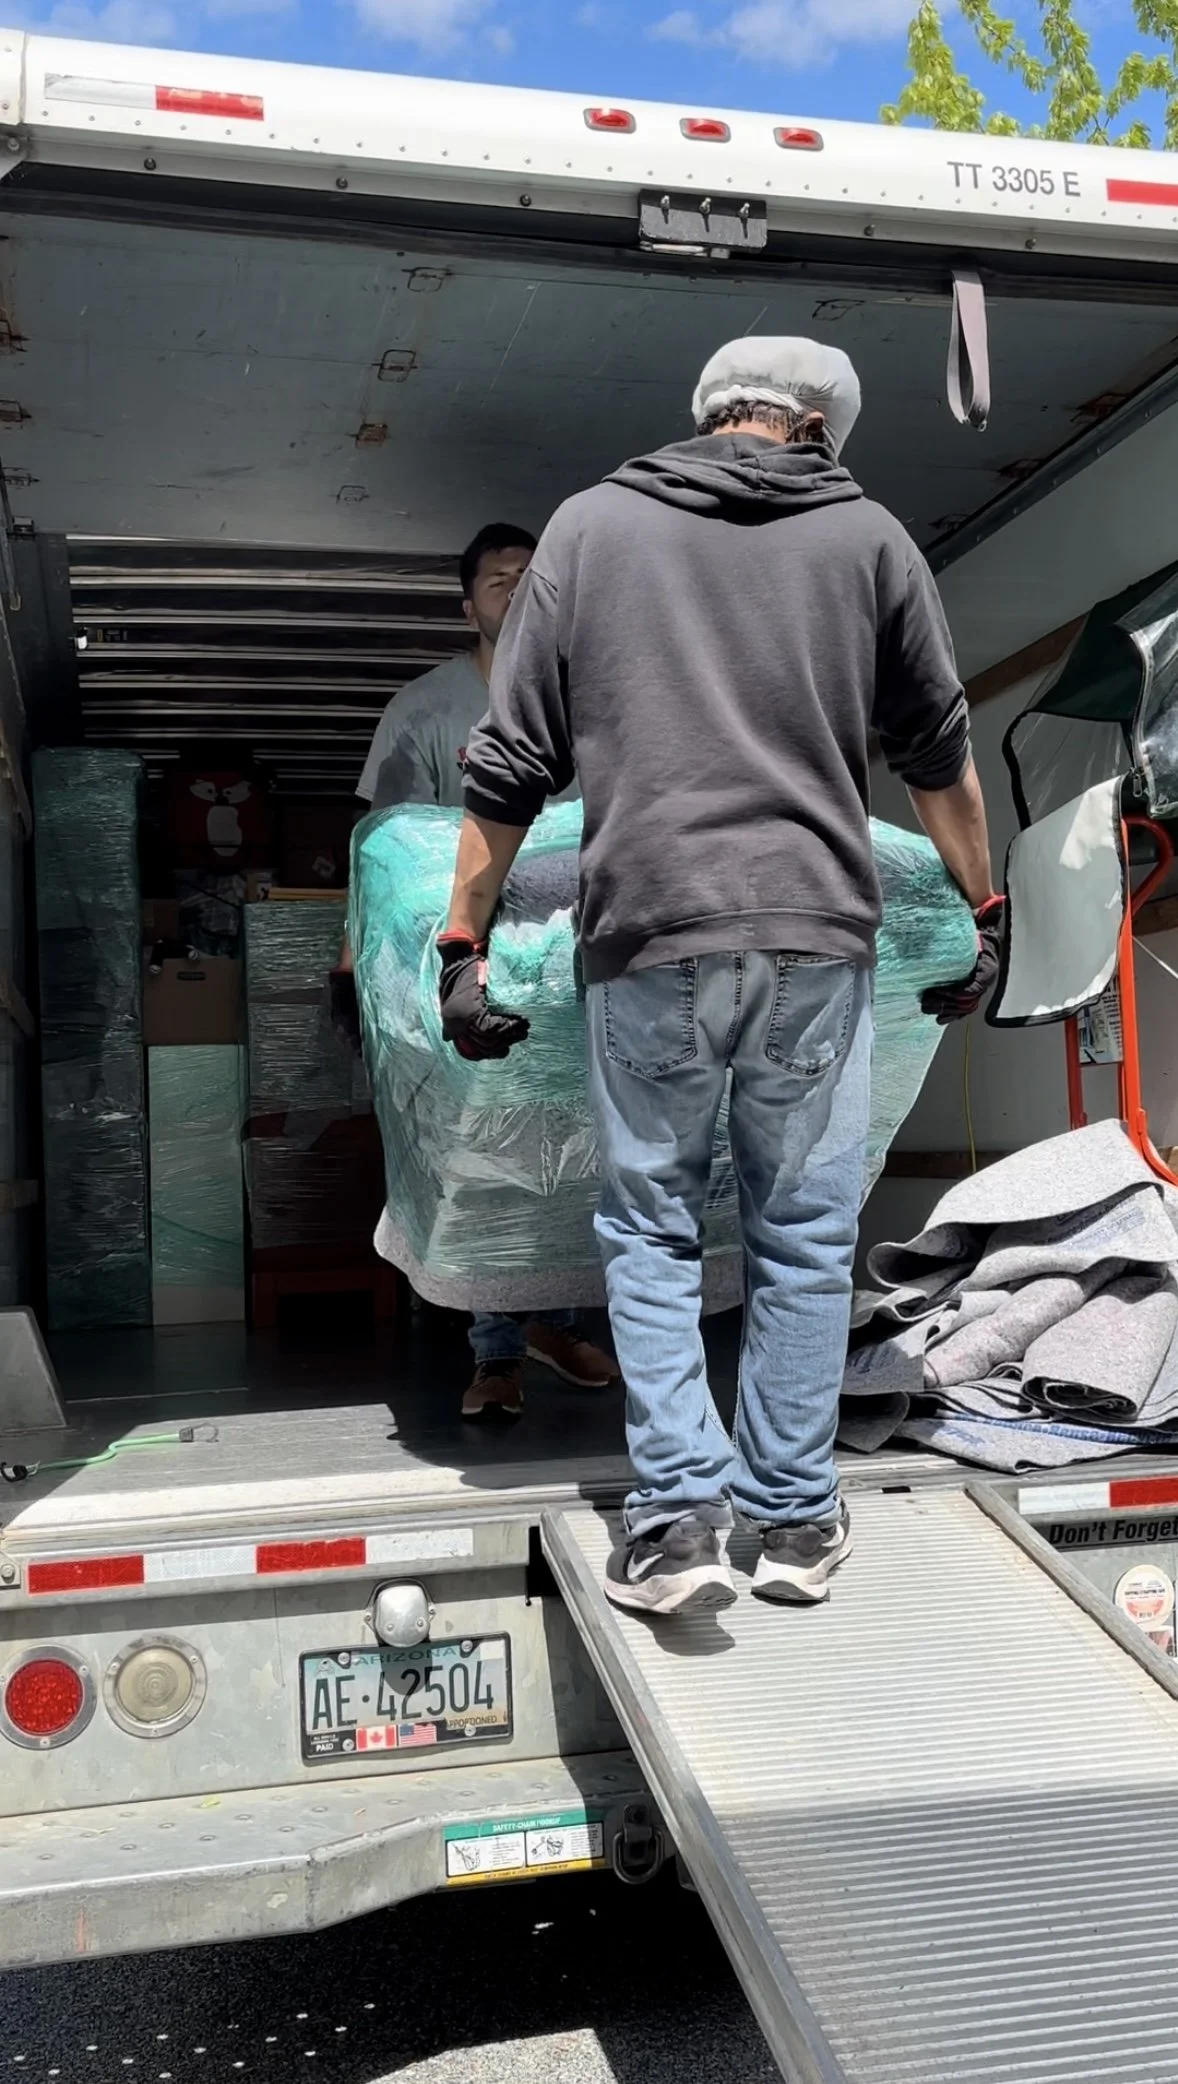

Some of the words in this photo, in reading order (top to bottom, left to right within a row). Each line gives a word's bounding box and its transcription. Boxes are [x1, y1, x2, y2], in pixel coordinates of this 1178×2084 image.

[947, 161, 982, 189] TT
[992, 166, 1055, 195] 3305
[1063, 171, 1081, 197] E
[1050, 1521, 1107, 1544] Don't
[356, 1647, 458, 1666] ARIZONA
[316, 1743, 334, 1752] PAID
